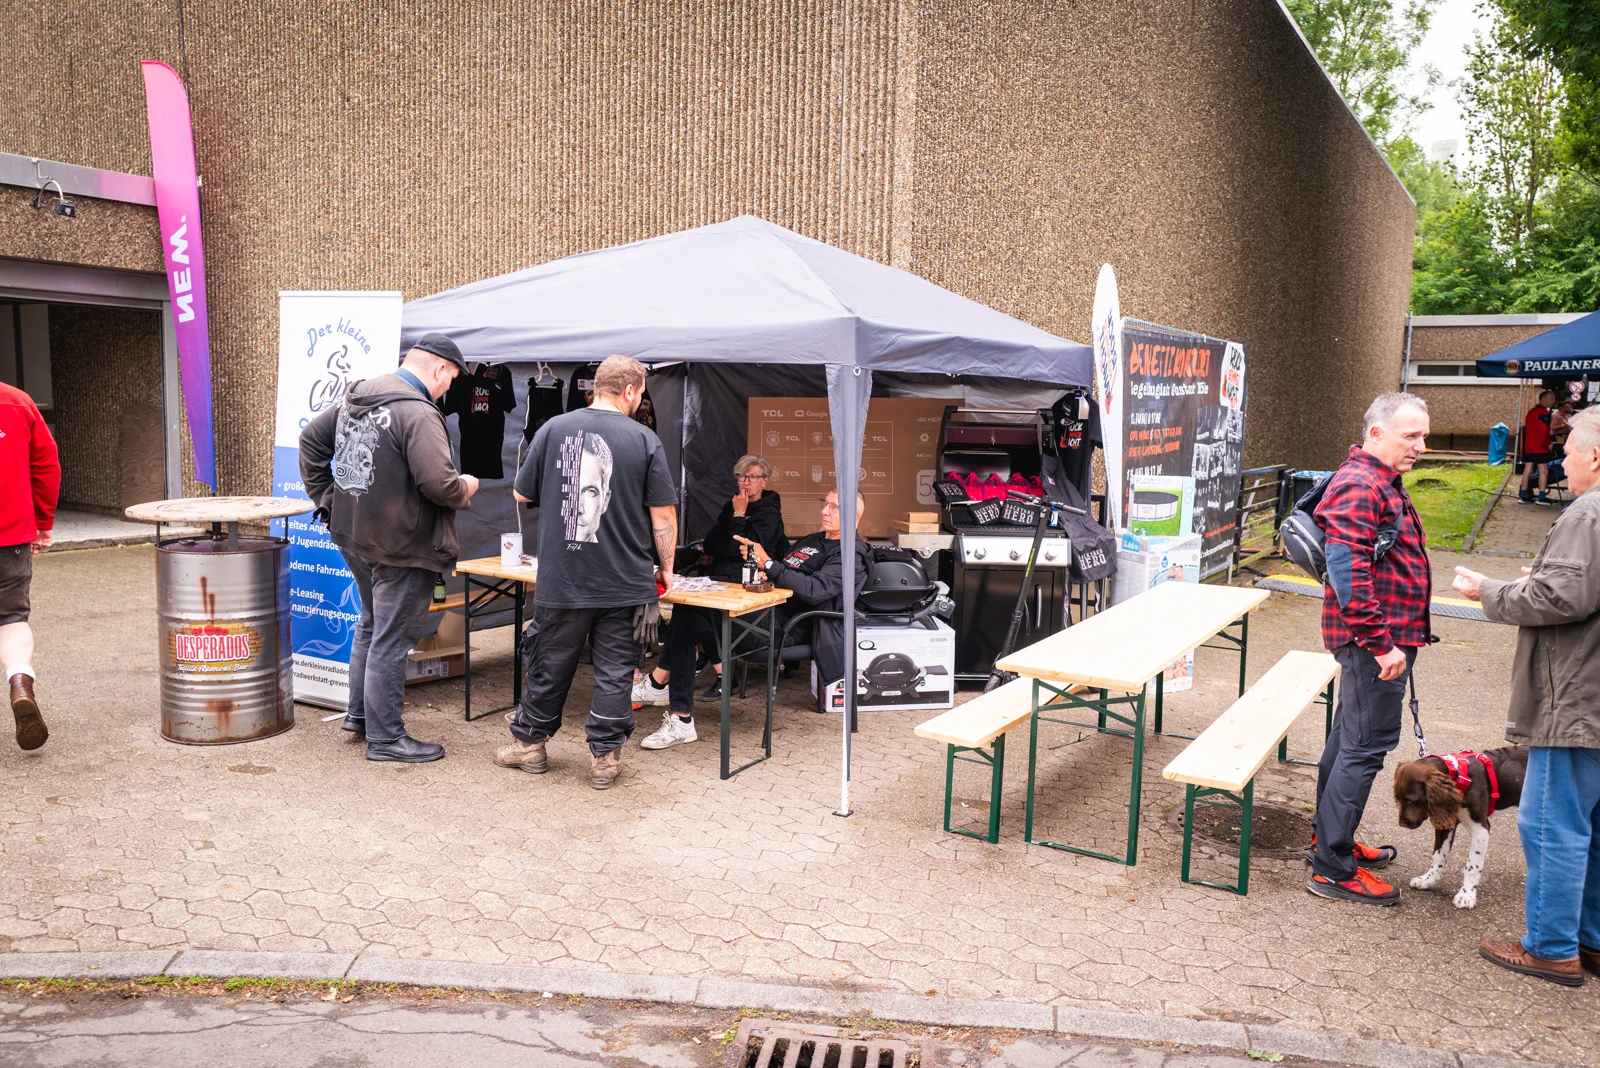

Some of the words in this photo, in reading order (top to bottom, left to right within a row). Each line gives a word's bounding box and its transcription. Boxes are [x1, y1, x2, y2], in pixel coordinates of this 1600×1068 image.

[307, 324, 332, 357] Der
[337, 317, 371, 354] kleine
[1524, 359, 1600, 371] PAULANER
[281, 517, 307, 529] beites
[976, 508, 1000, 524] HERO
[1003, 509, 1033, 524] HERO
[297, 536, 340, 551] Jugendräde
[290, 560, 315, 572] oderne
[316, 564, 355, 578] Fahrradwe
[1080, 553, 1106, 570] HERO
[290, 588, 324, 602] e-Leasing
[292, 603, 362, 622] nanzierungsexpert
[177, 634, 249, 661] DESPERADOS
[178, 664, 197, 672] Tequila
[199, 664, 231, 673] Flavoured
[293, 660, 349, 675] w.derkleineradladen
[293, 672, 349, 687] radwerkstatt-greven
